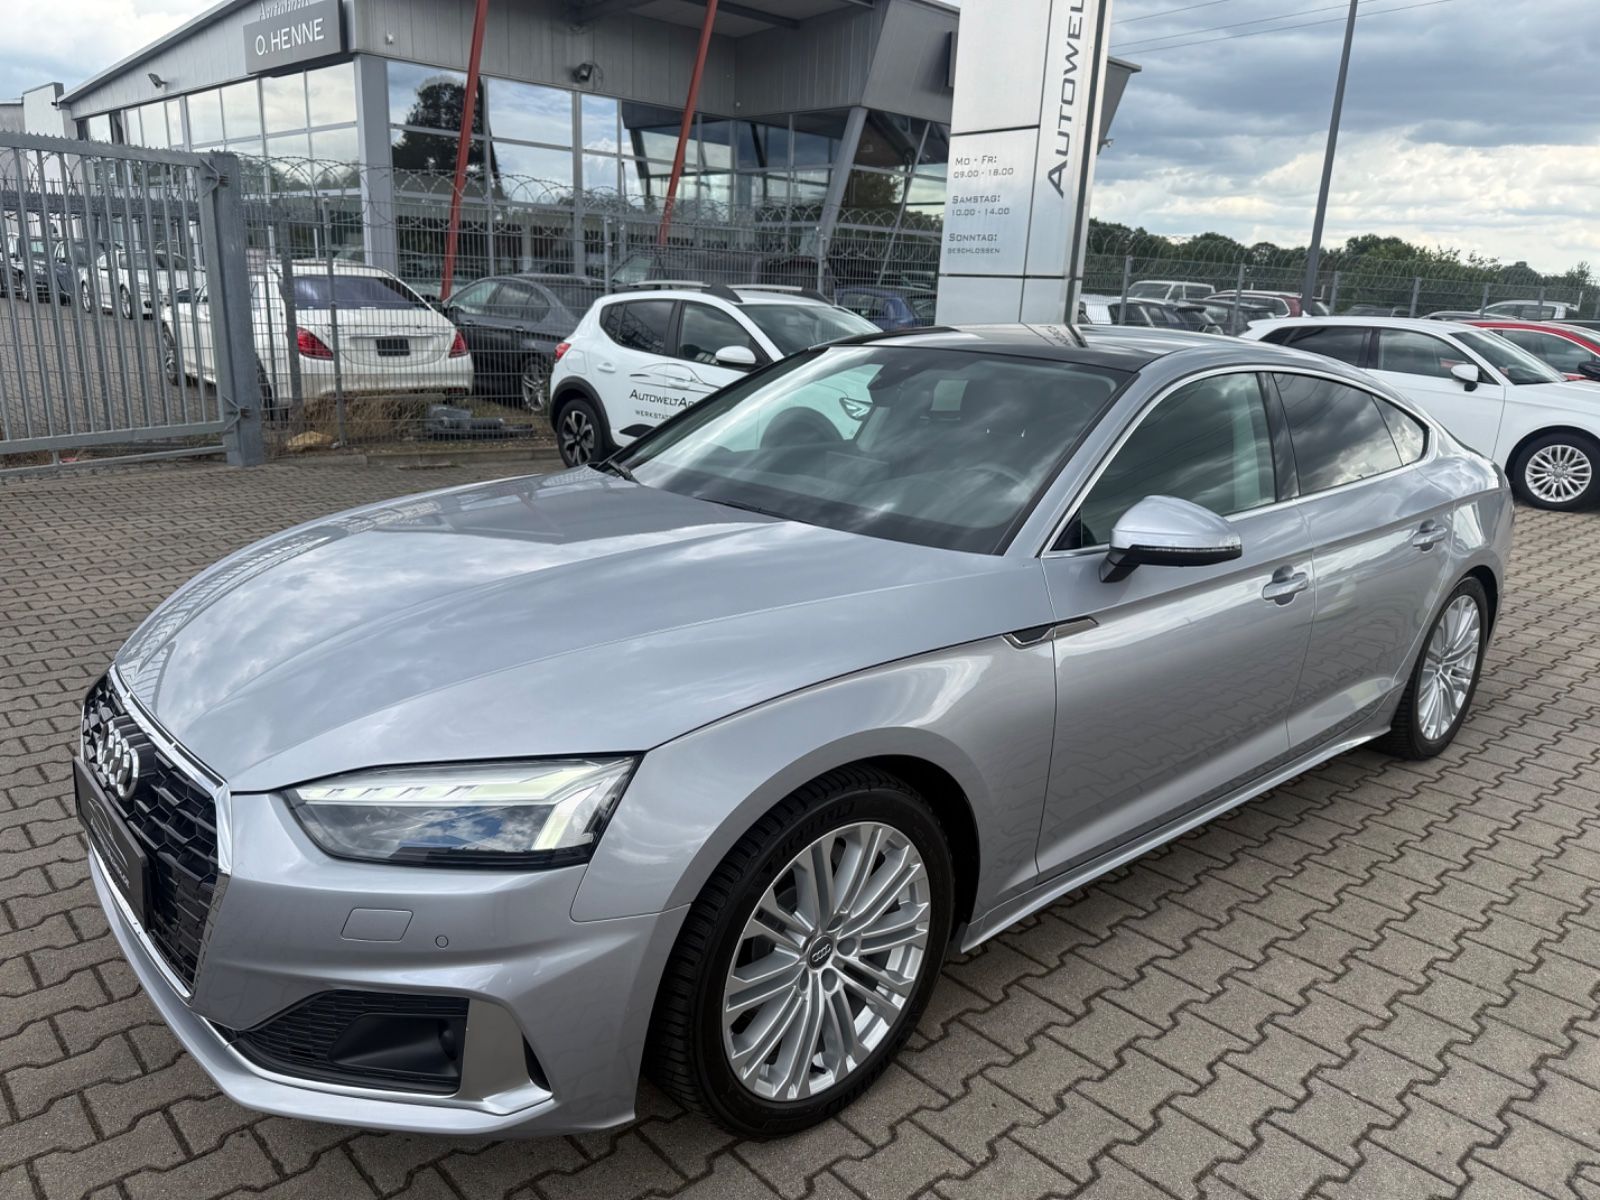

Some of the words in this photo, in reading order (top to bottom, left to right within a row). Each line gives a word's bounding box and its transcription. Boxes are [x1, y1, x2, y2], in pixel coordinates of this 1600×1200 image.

[270, 18, 325, 52] HENNE
[981, 155, 997, 164] FR:
[953, 170, 979, 179] 09.00
[988, 167, 1014, 176] 18.00
[952, 194, 1001, 204] SAMSTAG:
[952, 208, 976, 216] 10.00
[985, 207, 1010, 216] 14.00
[949, 232, 998, 242] SONNTAG:
